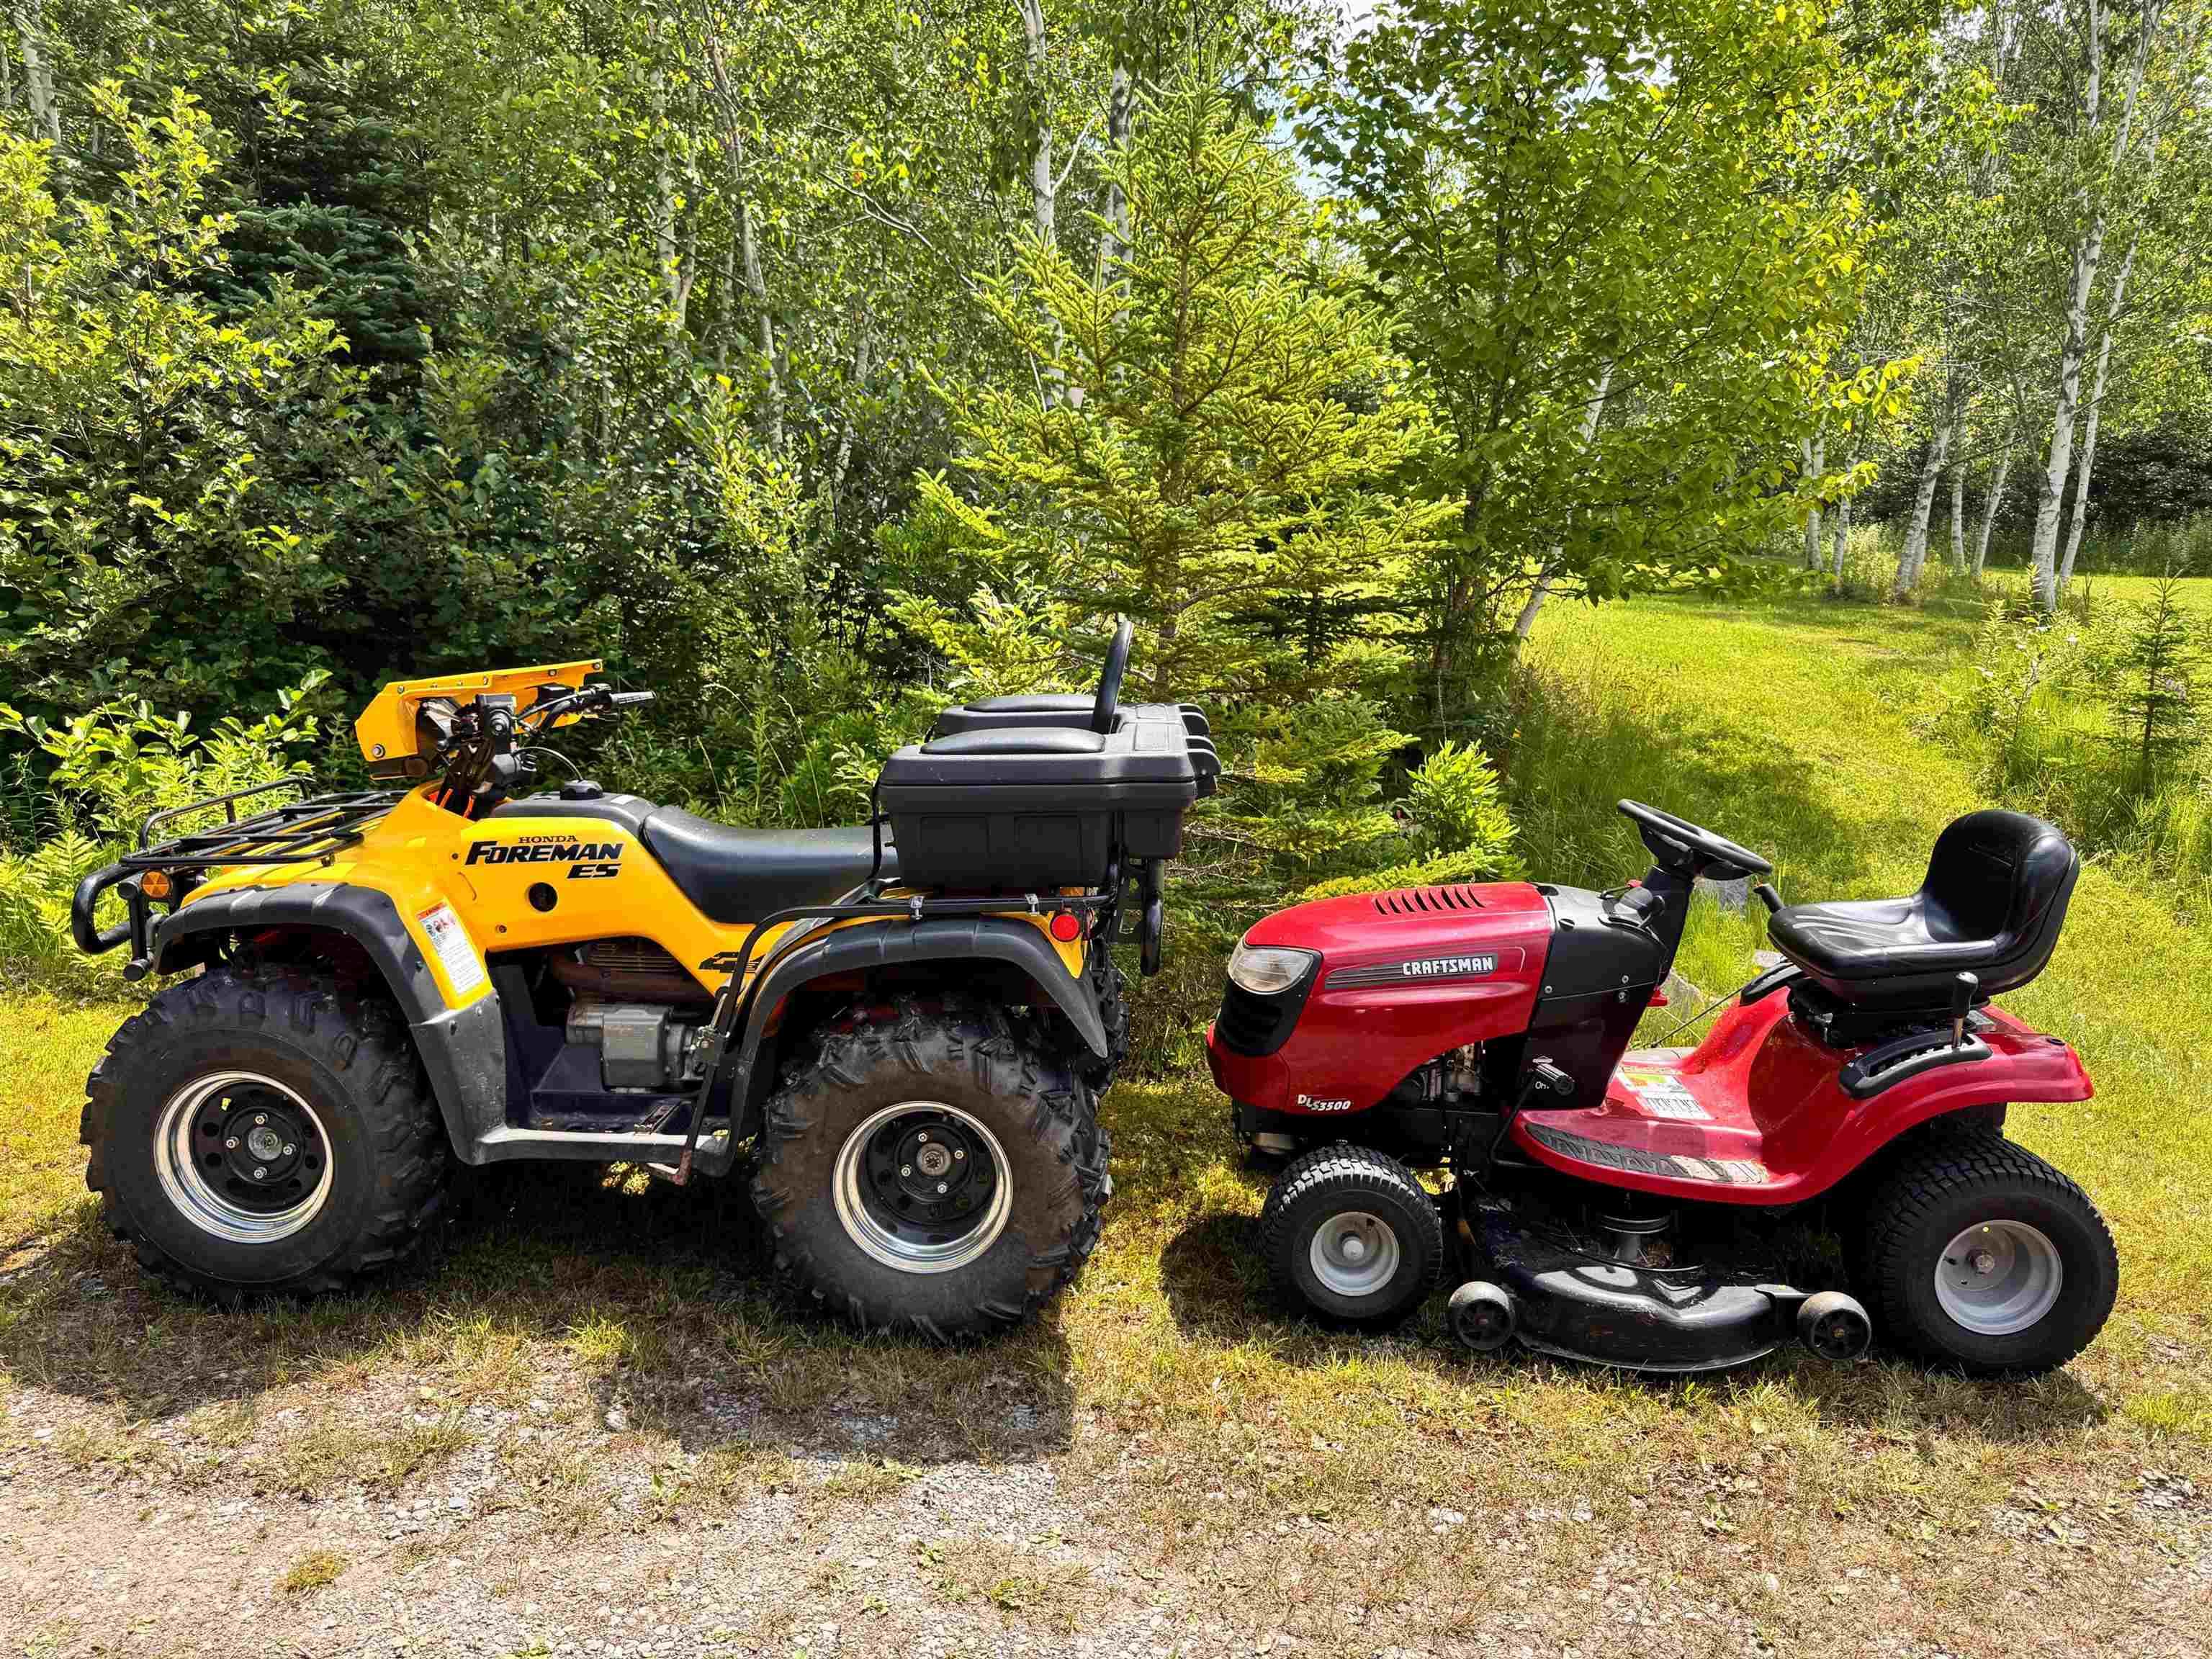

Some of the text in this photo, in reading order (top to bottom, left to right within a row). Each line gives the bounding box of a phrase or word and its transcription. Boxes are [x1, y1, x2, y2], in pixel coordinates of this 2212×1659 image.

[465, 841, 623, 865] FOREMAN
[567, 863, 621, 878] ES
[1403, 956, 1493, 976] CRAFTSMAN
